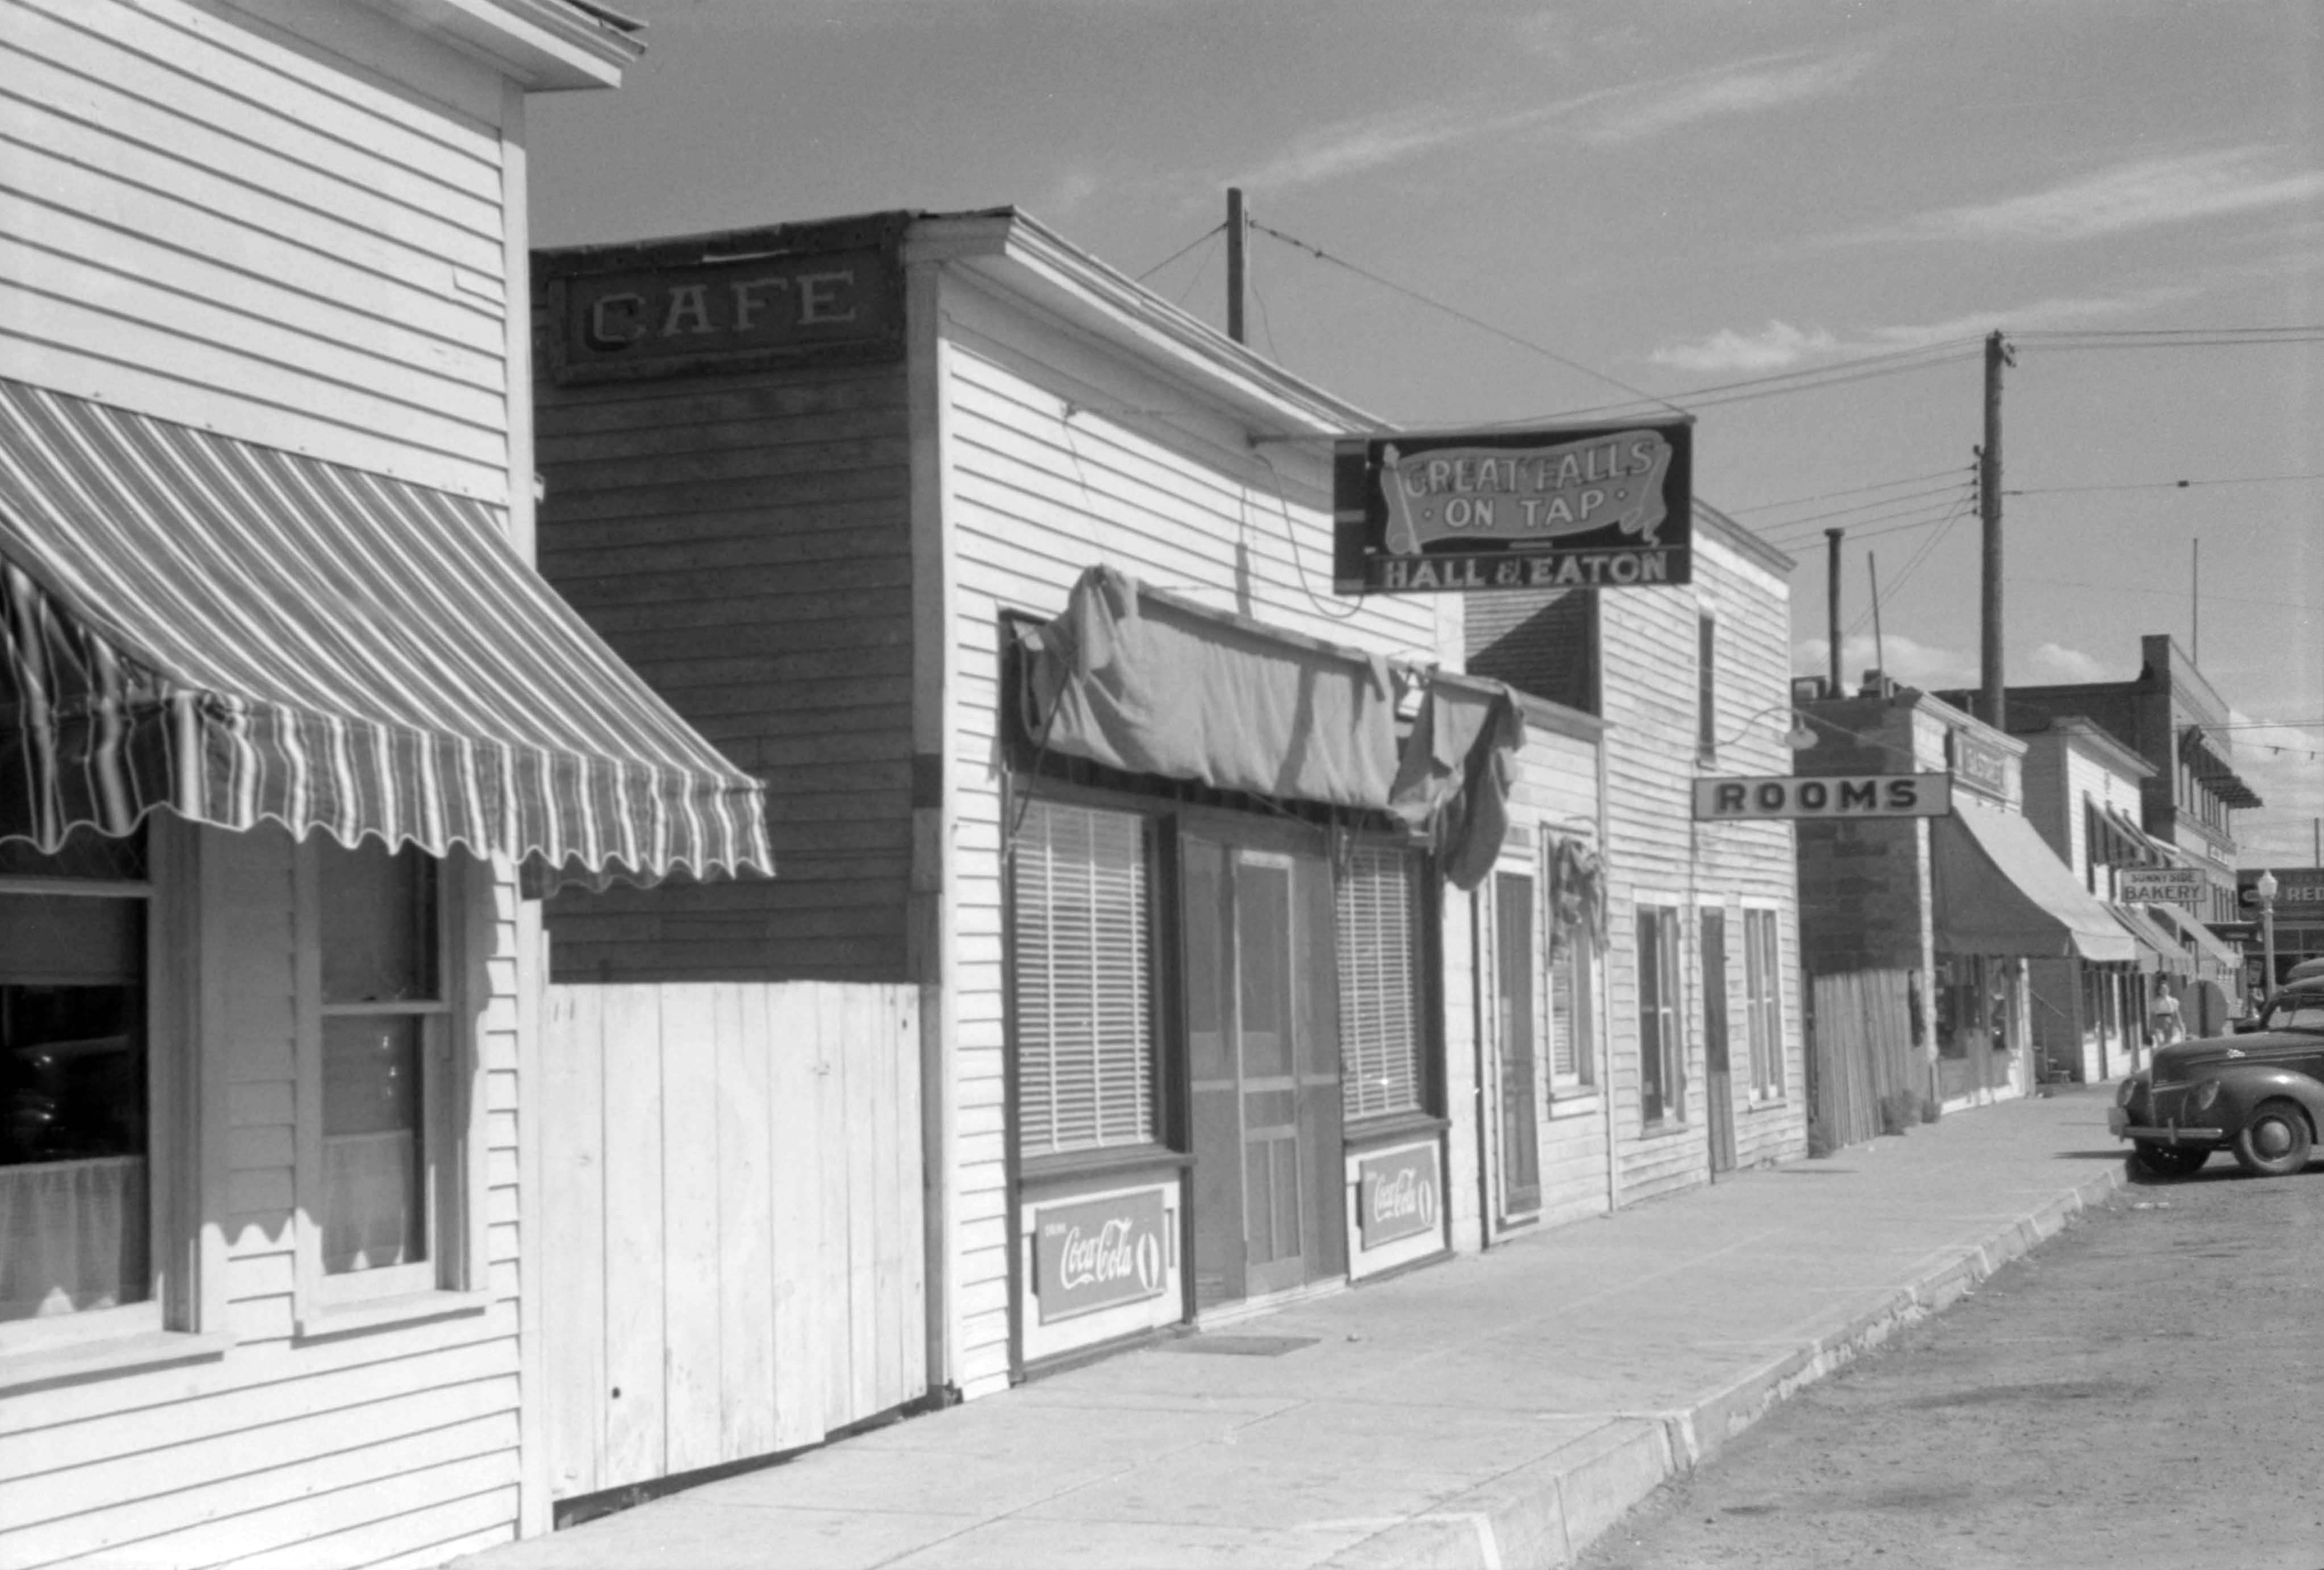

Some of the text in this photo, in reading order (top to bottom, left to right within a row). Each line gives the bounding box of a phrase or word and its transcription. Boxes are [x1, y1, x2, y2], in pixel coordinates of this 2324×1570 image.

[592, 270, 857, 343] CAFE
[1405, 443, 1654, 497] GREAT FALLS
[1445, 489, 1605, 528] ON TAP
[1384, 559, 1486, 589] HALL
[1529, 550, 1668, 585] EATON
[1714, 779, 1918, 814] ROOMS
[2124, 885, 2201, 900] BAKERY
